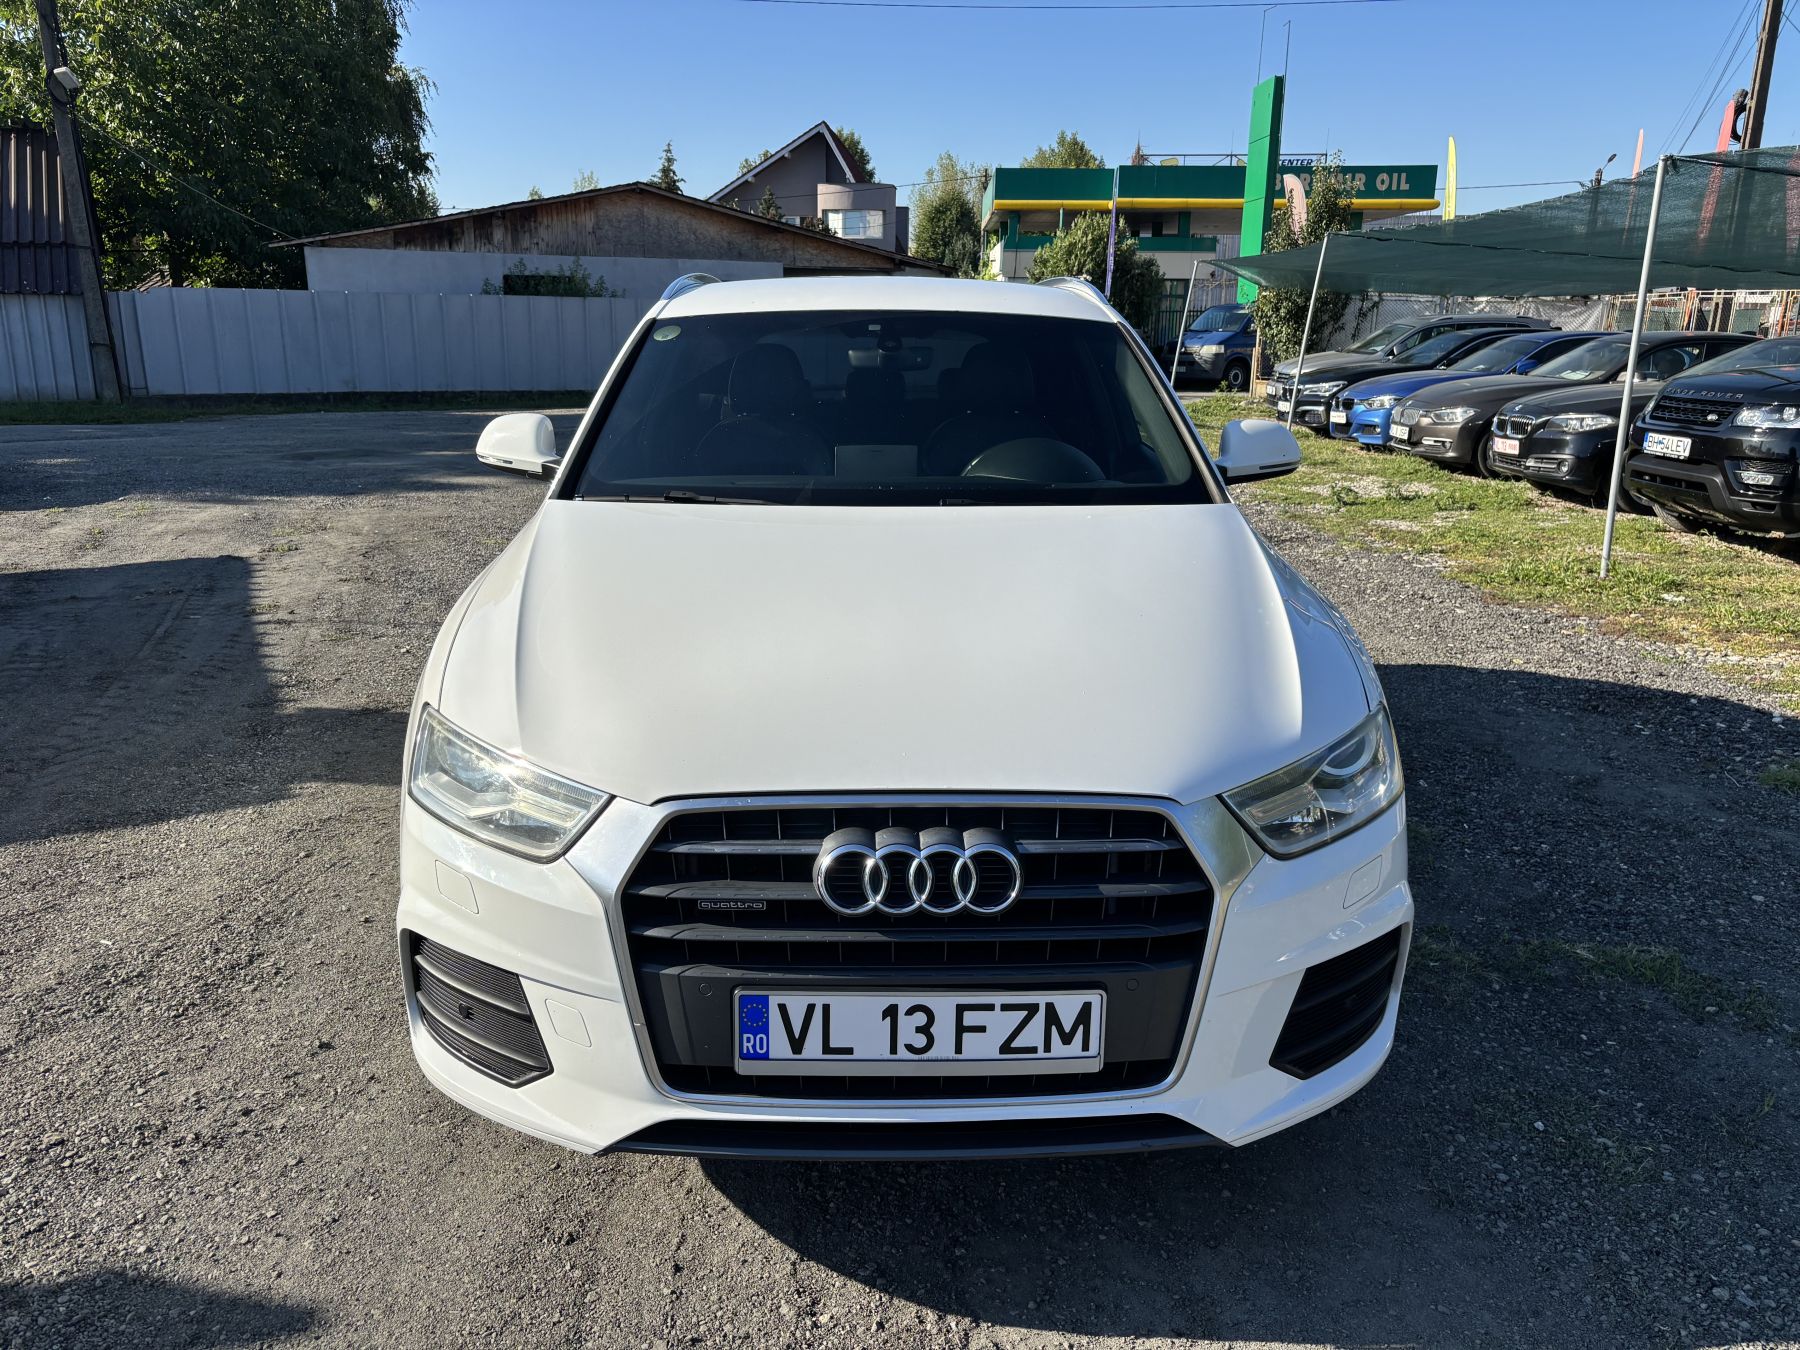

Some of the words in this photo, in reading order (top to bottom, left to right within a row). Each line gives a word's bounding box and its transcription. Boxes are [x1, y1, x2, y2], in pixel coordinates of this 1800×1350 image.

[1279, 158, 1313, 166] ENTER
[1375, 172, 1410, 191] OIL
[1700, 391, 1744, 399] ROVER
[701, 901, 763, 909] quattro
[777, 1002, 854, 1056] VL
[881, 1003, 936, 1056] 13
[955, 1001, 1092, 1055] FZM
[743, 1033, 767, 1054] RO
